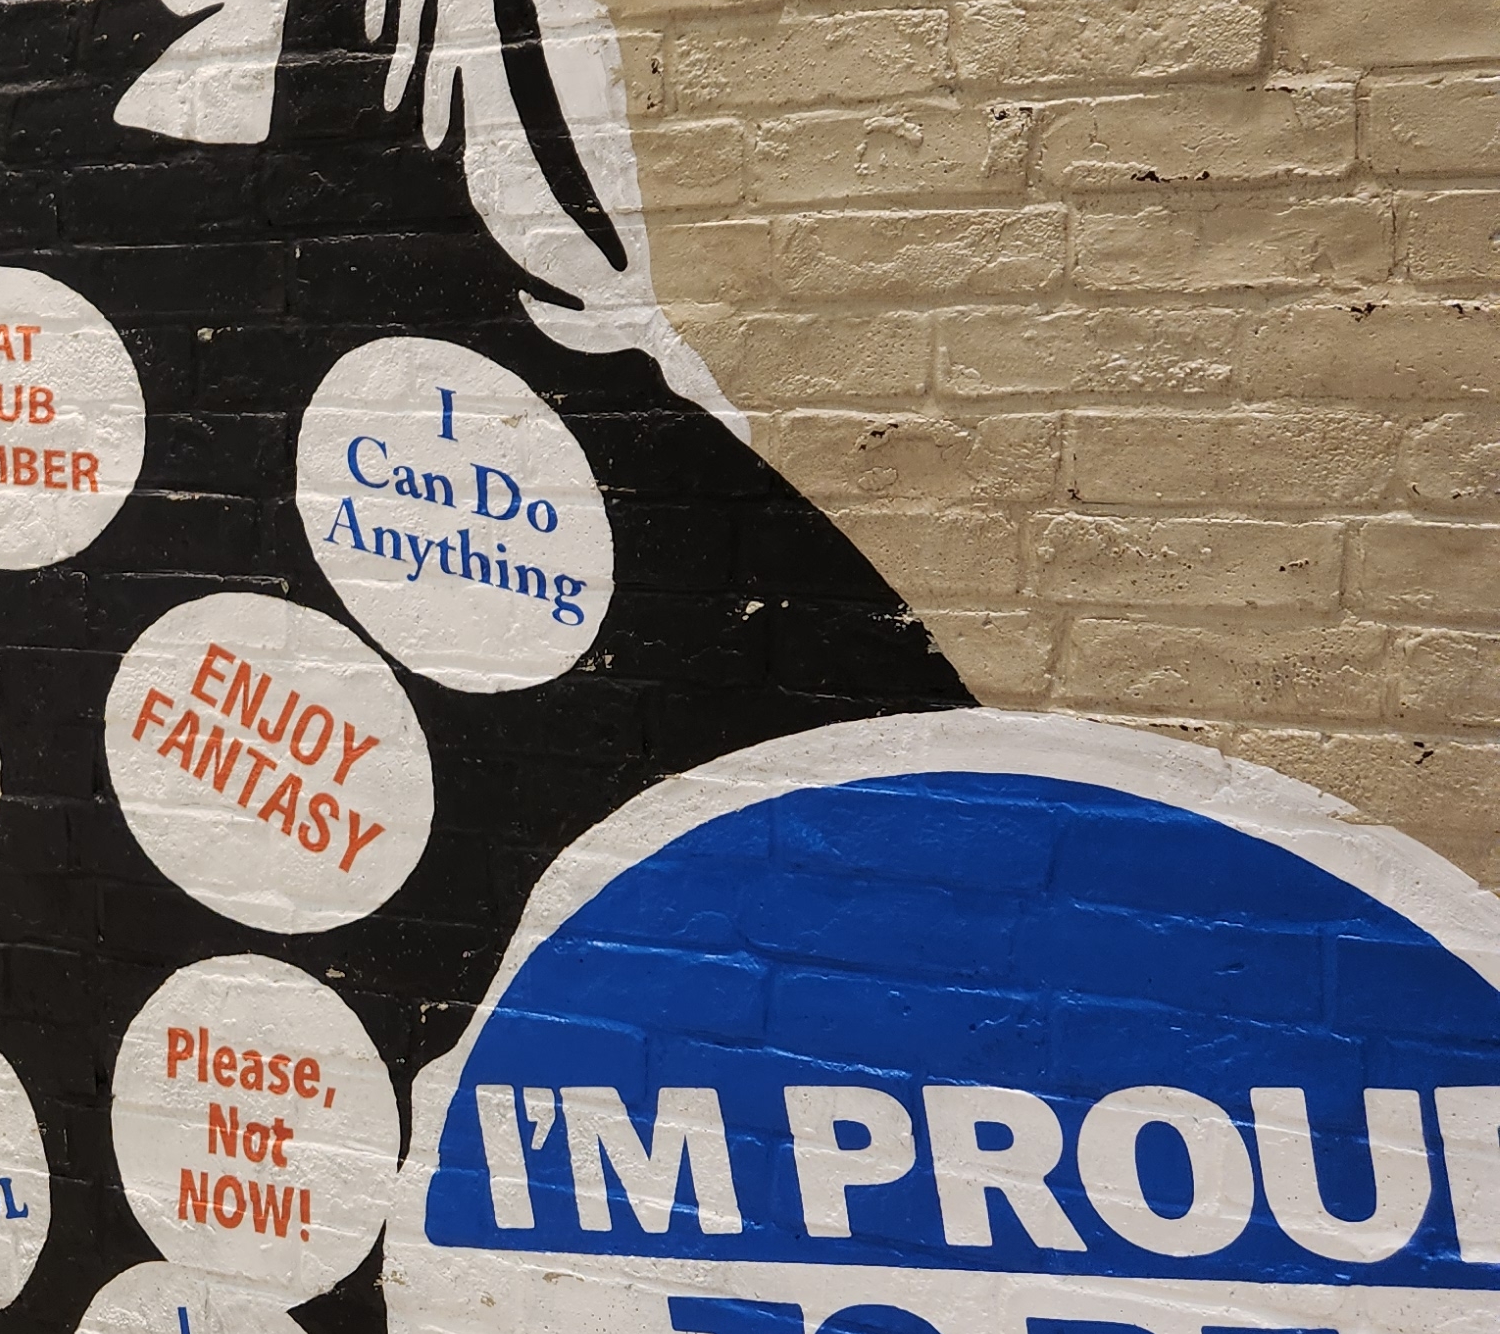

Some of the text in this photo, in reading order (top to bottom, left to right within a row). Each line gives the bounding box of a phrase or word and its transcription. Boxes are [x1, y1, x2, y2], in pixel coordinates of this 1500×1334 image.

[436, 386, 459, 444] I
[346, 435, 560, 534] Can Do
[323, 497, 589, 627] Anything
[190, 643, 381, 787] ENJOY
[131, 687, 385, 874] FANTASY
[166, 1027, 337, 1109] Please,
[207, 1102, 296, 1169] Not
[474, 1084, 1500, 1266] I'M PROU
[177, 1168, 313, 1243] NOW!
